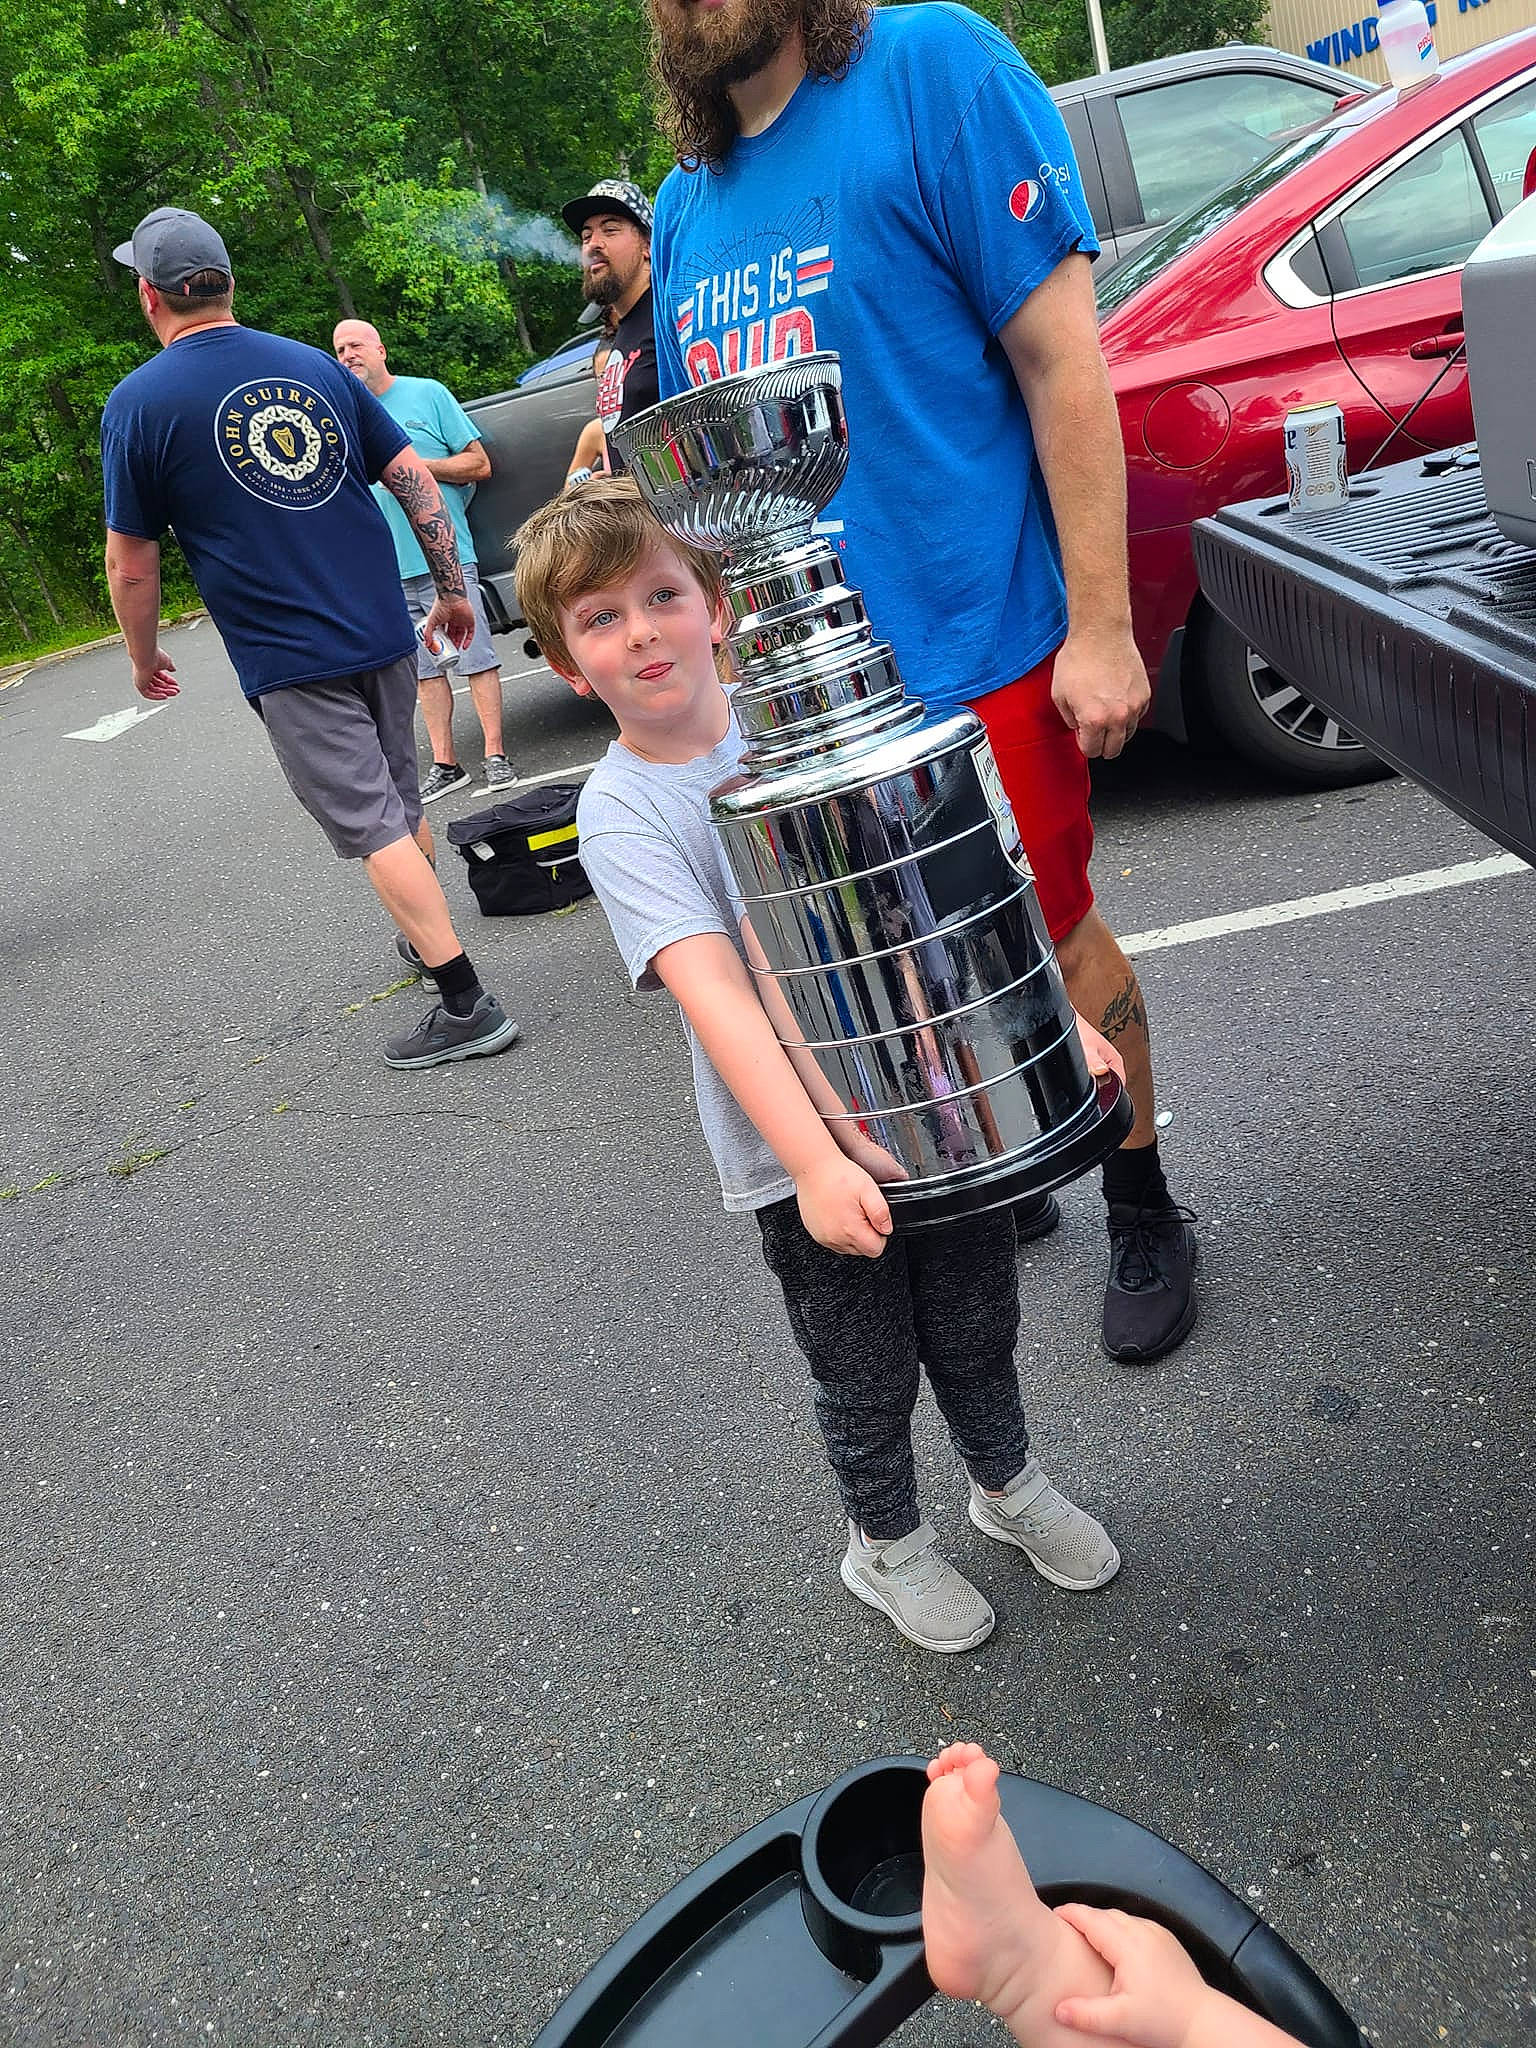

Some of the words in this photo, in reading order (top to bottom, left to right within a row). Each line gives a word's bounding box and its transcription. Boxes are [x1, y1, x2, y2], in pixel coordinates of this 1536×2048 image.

[695, 262, 760, 331] THIS
[768, 246, 793, 309] IS
[226, 409, 255, 469] JOHN
[243, 387, 317, 411] GUIRE
